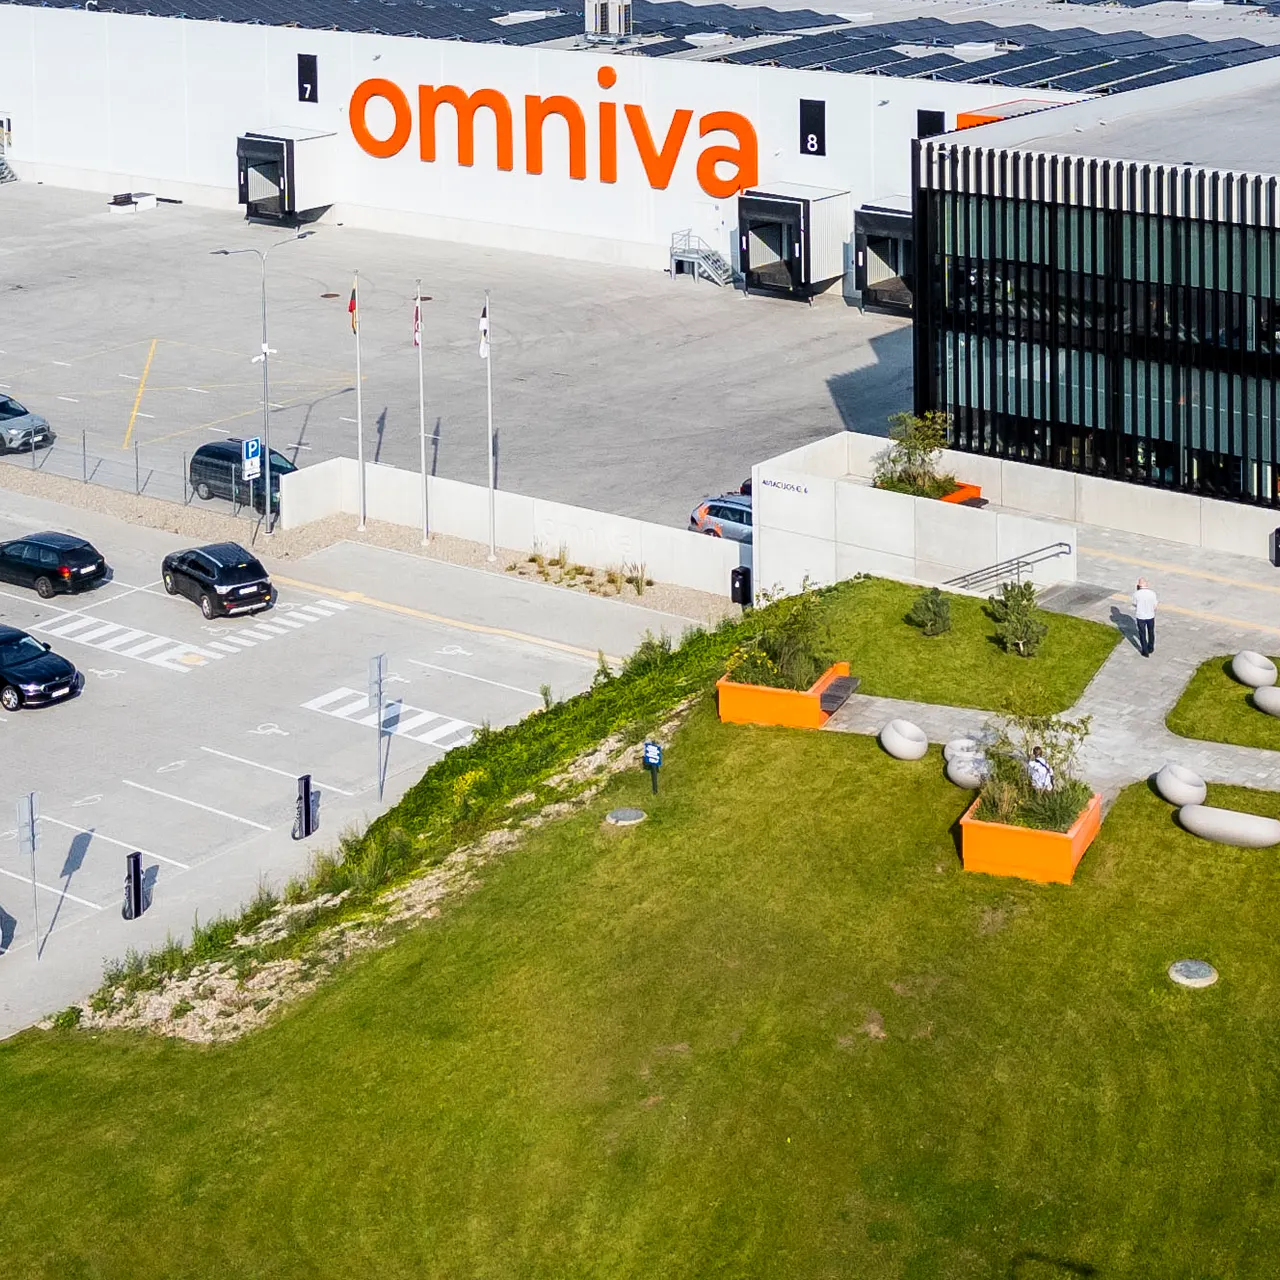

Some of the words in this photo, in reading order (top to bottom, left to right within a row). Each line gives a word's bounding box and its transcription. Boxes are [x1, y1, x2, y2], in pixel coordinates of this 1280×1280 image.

[303, 83, 311, 99] 7
[350, 66, 757, 198] omniva
[807, 133, 818, 152] 8
[248, 440, 258, 458] P
